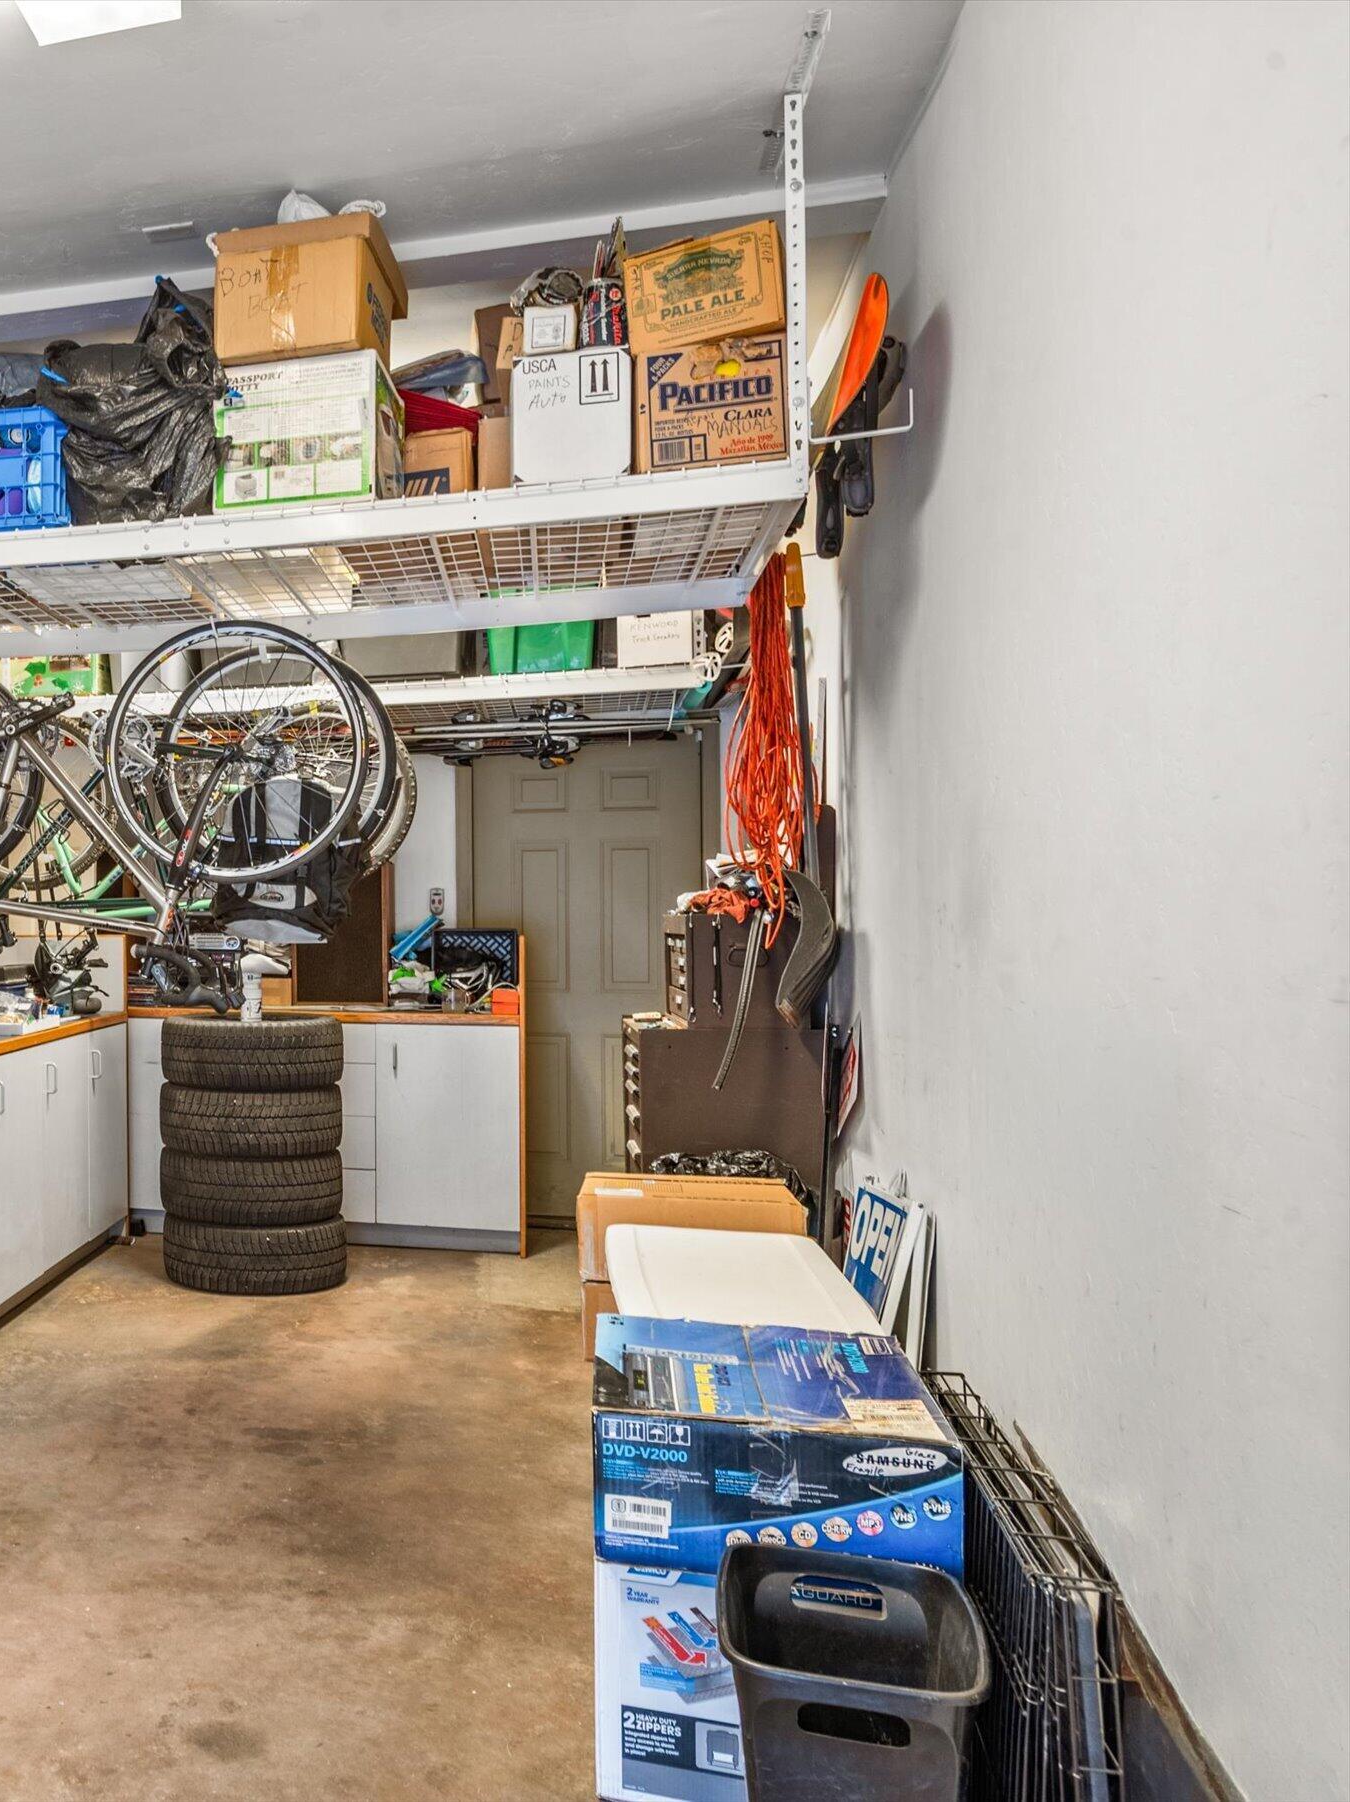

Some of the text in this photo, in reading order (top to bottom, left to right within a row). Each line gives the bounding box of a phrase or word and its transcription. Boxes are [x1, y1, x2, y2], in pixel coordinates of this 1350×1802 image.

[218, 258, 279, 297] BOAT
[661, 289, 746, 321] PALE ALE
[522, 358, 556, 374] USCA
[226, 370, 284, 387] PASSPORT
[529, 375, 570, 389] PAINTS
[228, 383, 259, 393] OTTY
[658, 374, 773, 411] PACIFICO
[528, 391, 566, 410] Auto
[723, 407, 772, 422] CLARA
[707, 417, 778, 438] MANUALS
[630, 619, 679, 632] KENWOOD
[850, 1193, 904, 1285] OPEN
[602, 1442, 688, 1463] DVD-V2000
[904, 1447, 937, 1460] Glass
[856, 1453, 936, 1470] SAMSUNG
[845, 1462, 885, 1477] Fragile
[922, 1500, 953, 1514] S-VHS
[860, 1518, 881, 1529] MP3
[893, 1511, 915, 1523] VHS
[798, 1530, 812, 1541] CD
[626, 1587, 649, 1599] 2 YEAR
[627, 1595, 660, 1606] WARRANTY
[623, 1711, 677, 1729] 2 HEAVY DUTY
[636, 1721, 682, 1738] ZIPPERS
